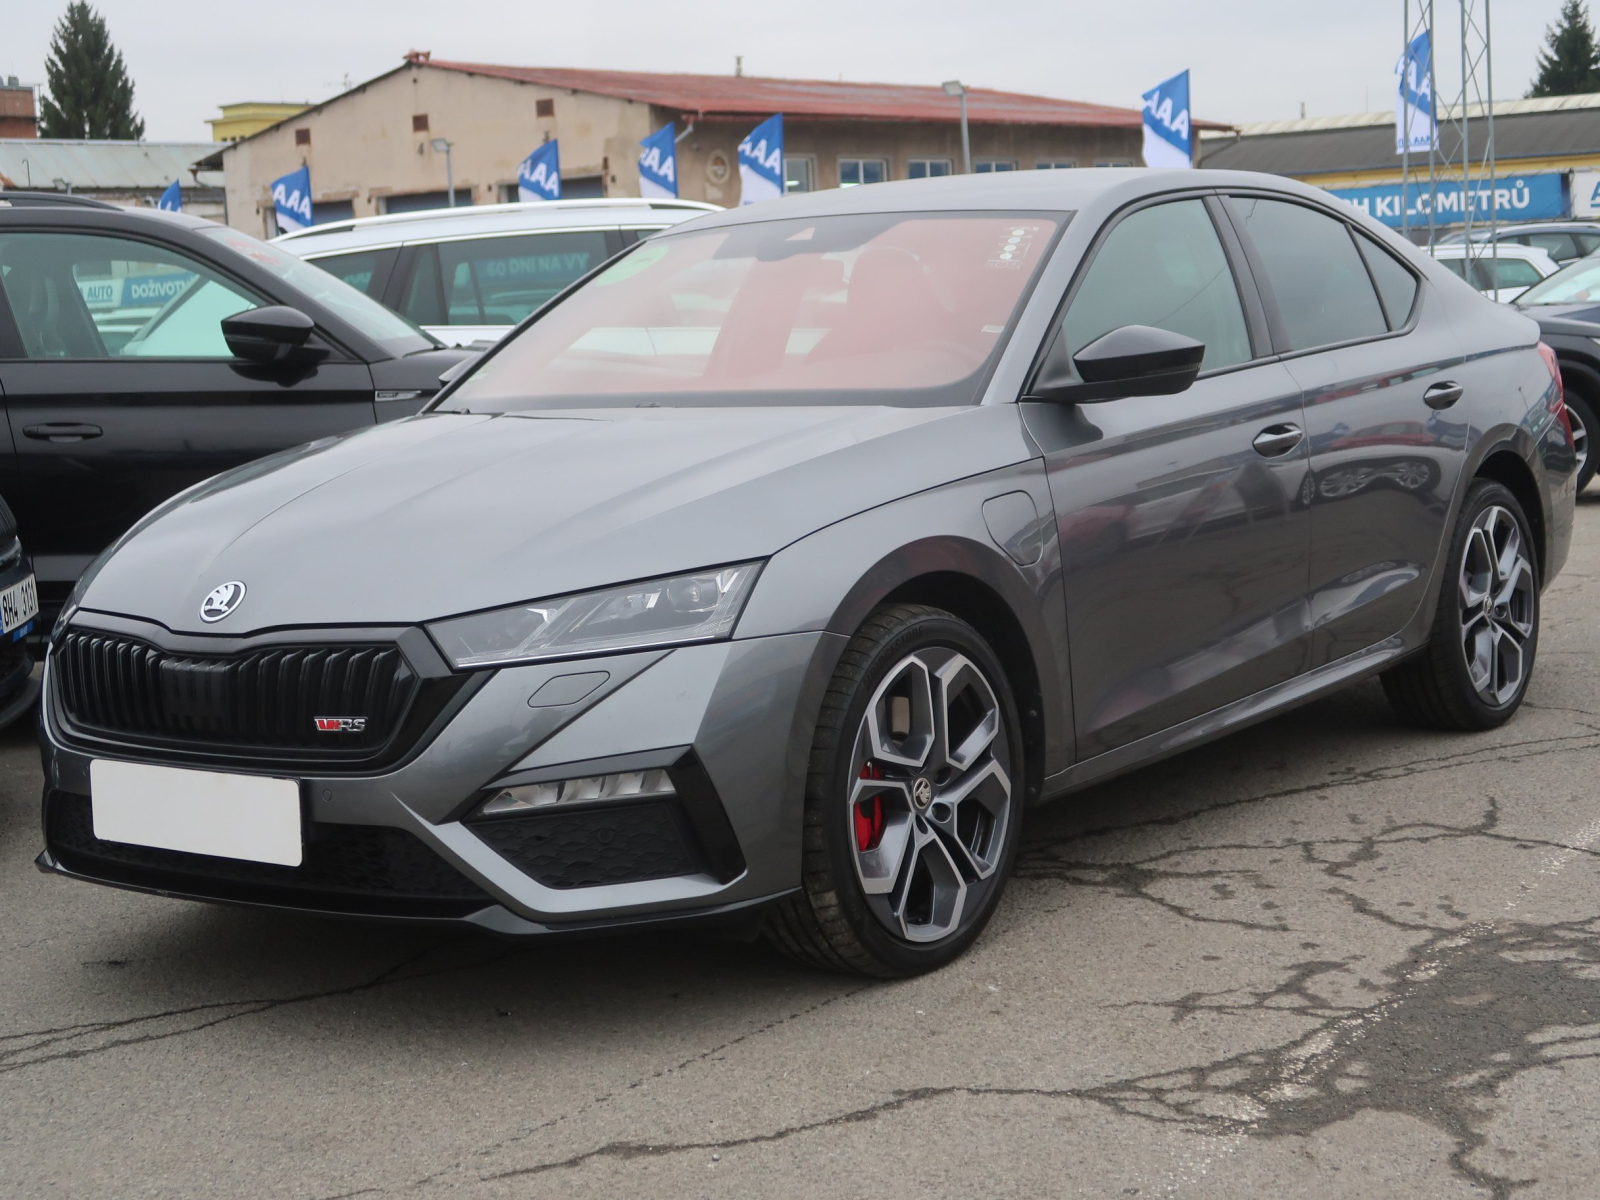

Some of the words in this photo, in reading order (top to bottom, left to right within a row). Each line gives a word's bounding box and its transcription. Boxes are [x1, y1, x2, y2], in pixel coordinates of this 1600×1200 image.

[272, 184, 312, 222] AAA
[1376, 179, 1530, 217] KILOMETRŮ
[87, 285, 113, 301] AUTO
[3, 590, 19, 629] 8H4
[21, 579, 38, 617] 3131
